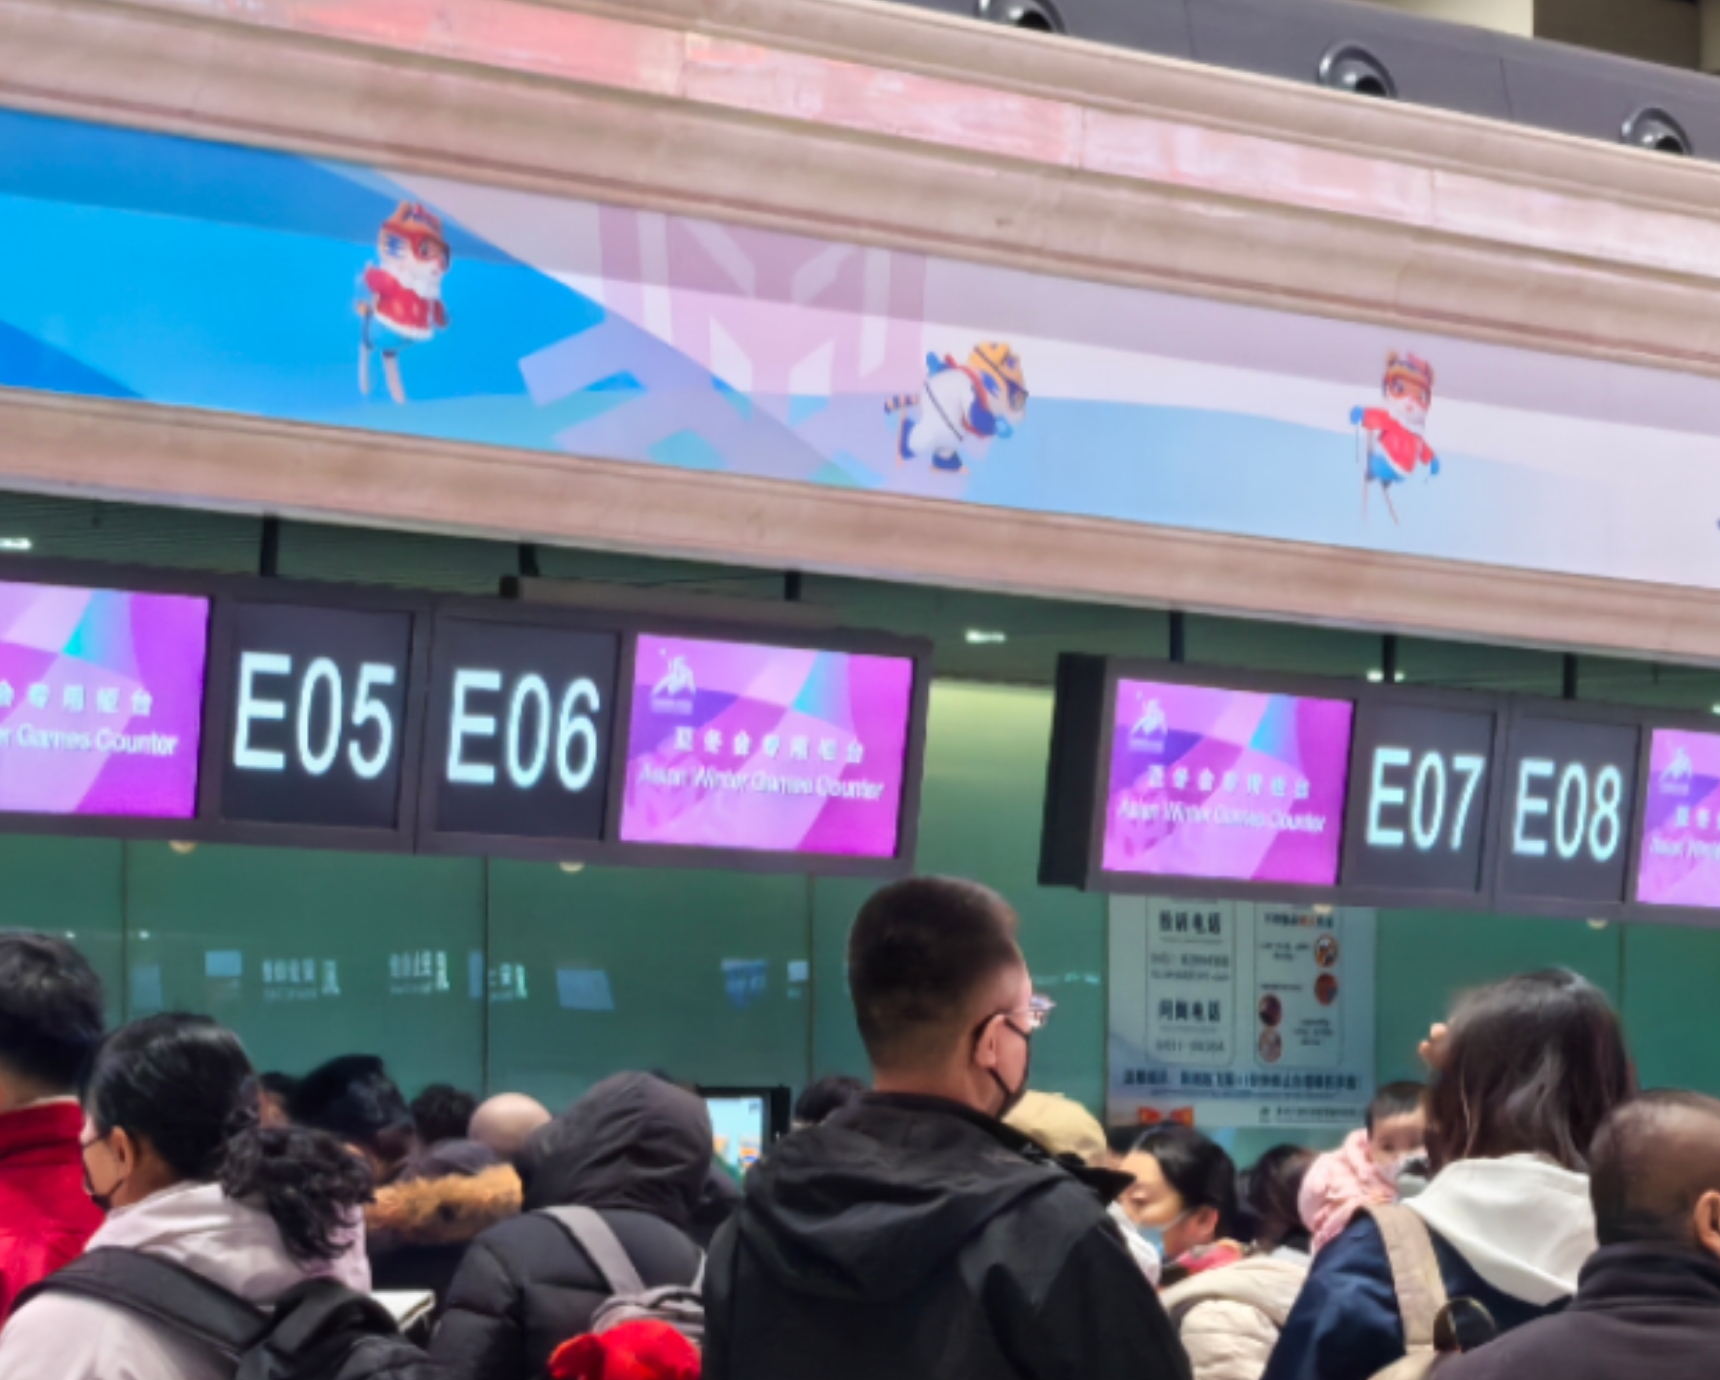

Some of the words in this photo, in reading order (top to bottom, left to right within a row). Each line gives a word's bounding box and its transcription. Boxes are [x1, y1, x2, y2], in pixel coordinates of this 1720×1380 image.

[97, 726, 179, 756] Counter
[233, 652, 395, 778] E05
[447, 669, 600, 790] E06
[816, 775, 885, 801] Counter
[1366, 746, 1485, 850] E07
[1513, 758, 1622, 861] E08
